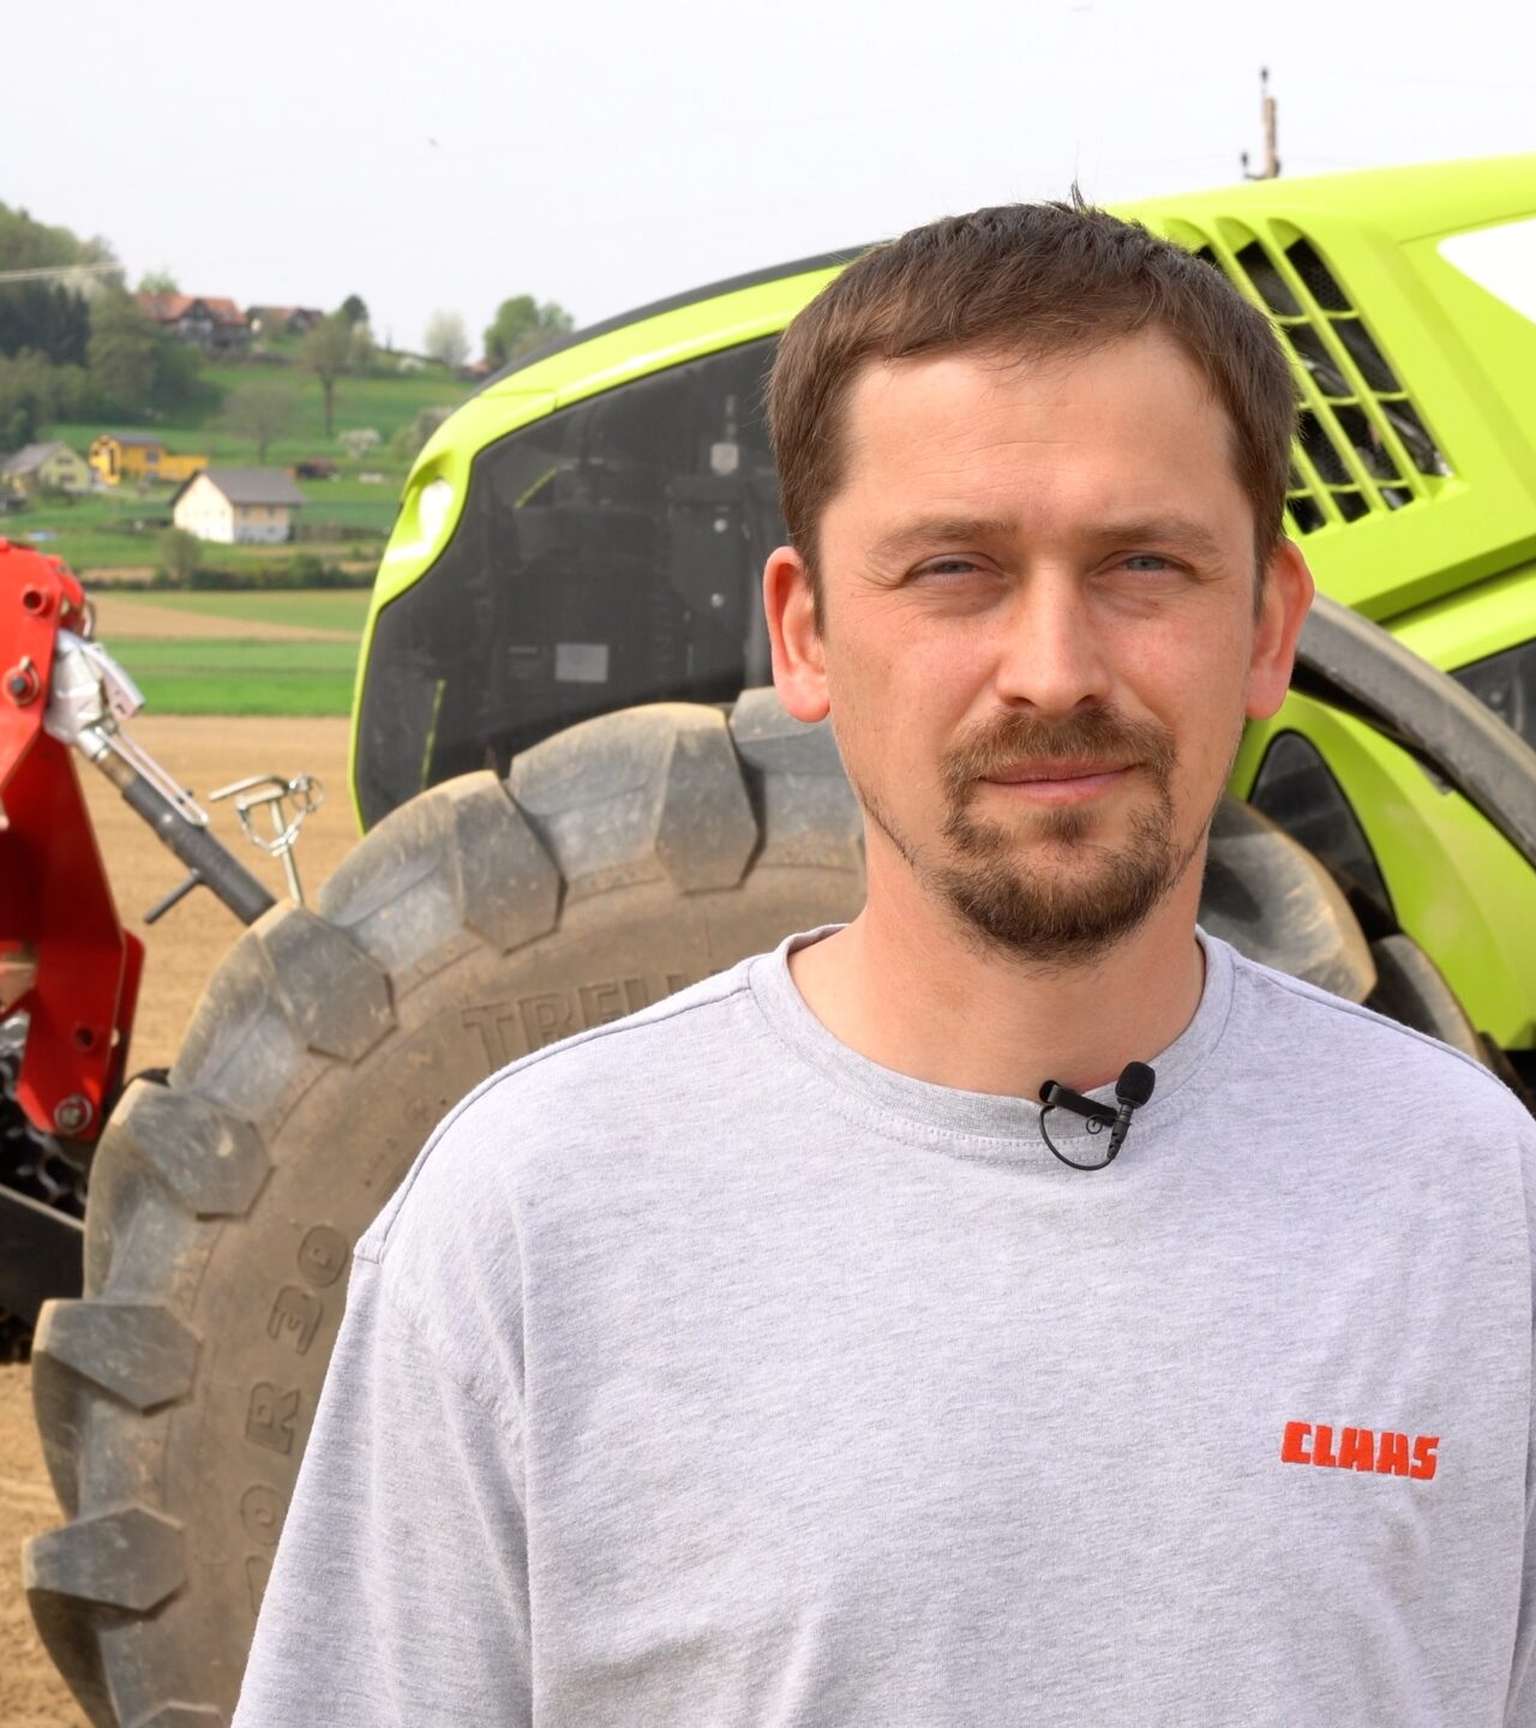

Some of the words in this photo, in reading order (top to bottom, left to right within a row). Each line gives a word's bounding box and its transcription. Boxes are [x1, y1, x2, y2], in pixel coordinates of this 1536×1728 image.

[267, 1225, 350, 1355] 30
[246, 1381, 300, 1455] R
[1281, 1421, 1440, 1480] CLAAS
